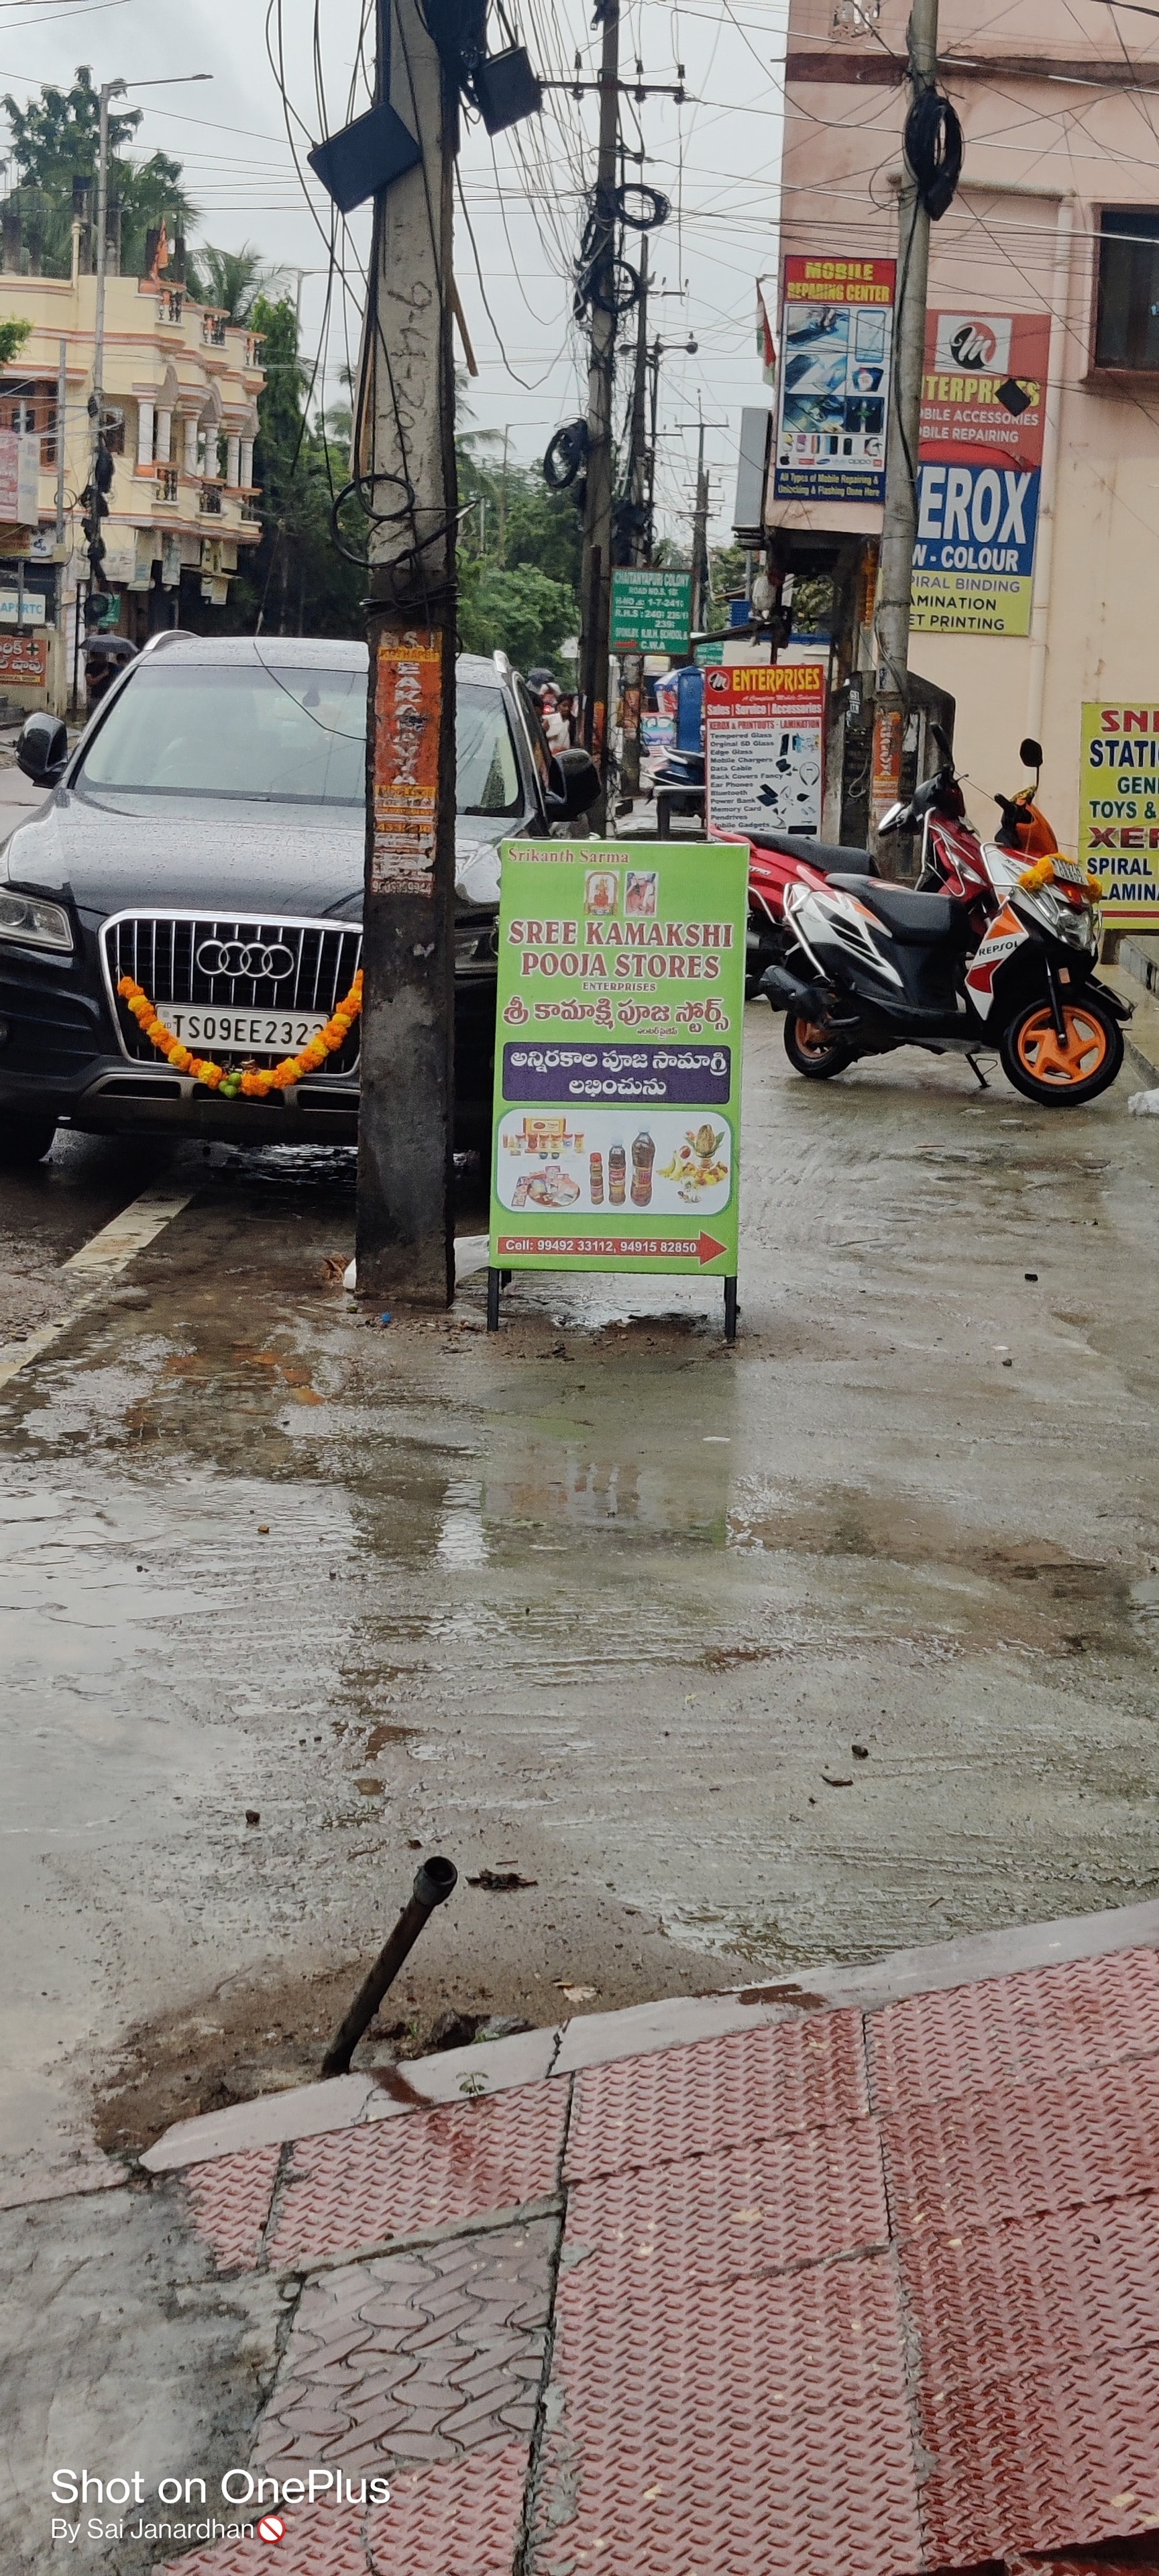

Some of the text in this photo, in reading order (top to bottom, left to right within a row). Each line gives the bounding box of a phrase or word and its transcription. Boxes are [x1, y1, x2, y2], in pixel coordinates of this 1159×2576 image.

[806, 262, 874, 281] MOBILE
[846, 284, 890, 302] CENTER
[922, 376, 1040, 408] TERPRIS
[953, 410, 1038, 426] ACCESSORIES
[952, 428, 1019, 443] REPAIRING
[917, 466, 1032, 544] EROX
[941, 546, 1019, 572] COLOUR
[664, 573, 690, 587] COLONY
[956, 578, 1020, 592] BINDING
[1, 602, 43, 614] APRTC
[930, 615, 1005, 631] PRINTING
[732, 668, 820, 693] ENTERPRISES
[707, 702, 822, 716] Sales Service Accessories
[1090, 739, 1159, 767] STATI
[1117, 776, 1159, 794] GEN
[1089, 801, 1156, 819] TOYS &
[508, 848, 629, 863] Srikanth Sarma
[1087, 857, 1153, 875] SPIRAL
[1101, 883, 1159, 901] AMIN
[508, 920, 733, 948] SREE KAMAKSHI
[979, 941, 1019, 957] REPSOL
[521, 952, 720, 979] POOJA STORES
[583, 982, 656, 992] ENTERPRISES
[504, 996, 529, 1026] శ్రీ
[535, 998, 614, 1030] కామాక్షి
[617, 999, 670, 1026] పూజ
[510, 1050, 728, 1076] అన్నిరకాల పూజ సామాగ్రి
[569, 1077, 667, 1097] లభించును
[506, 1240, 696, 1253] Cell: 99492 33112, 94915 82850
